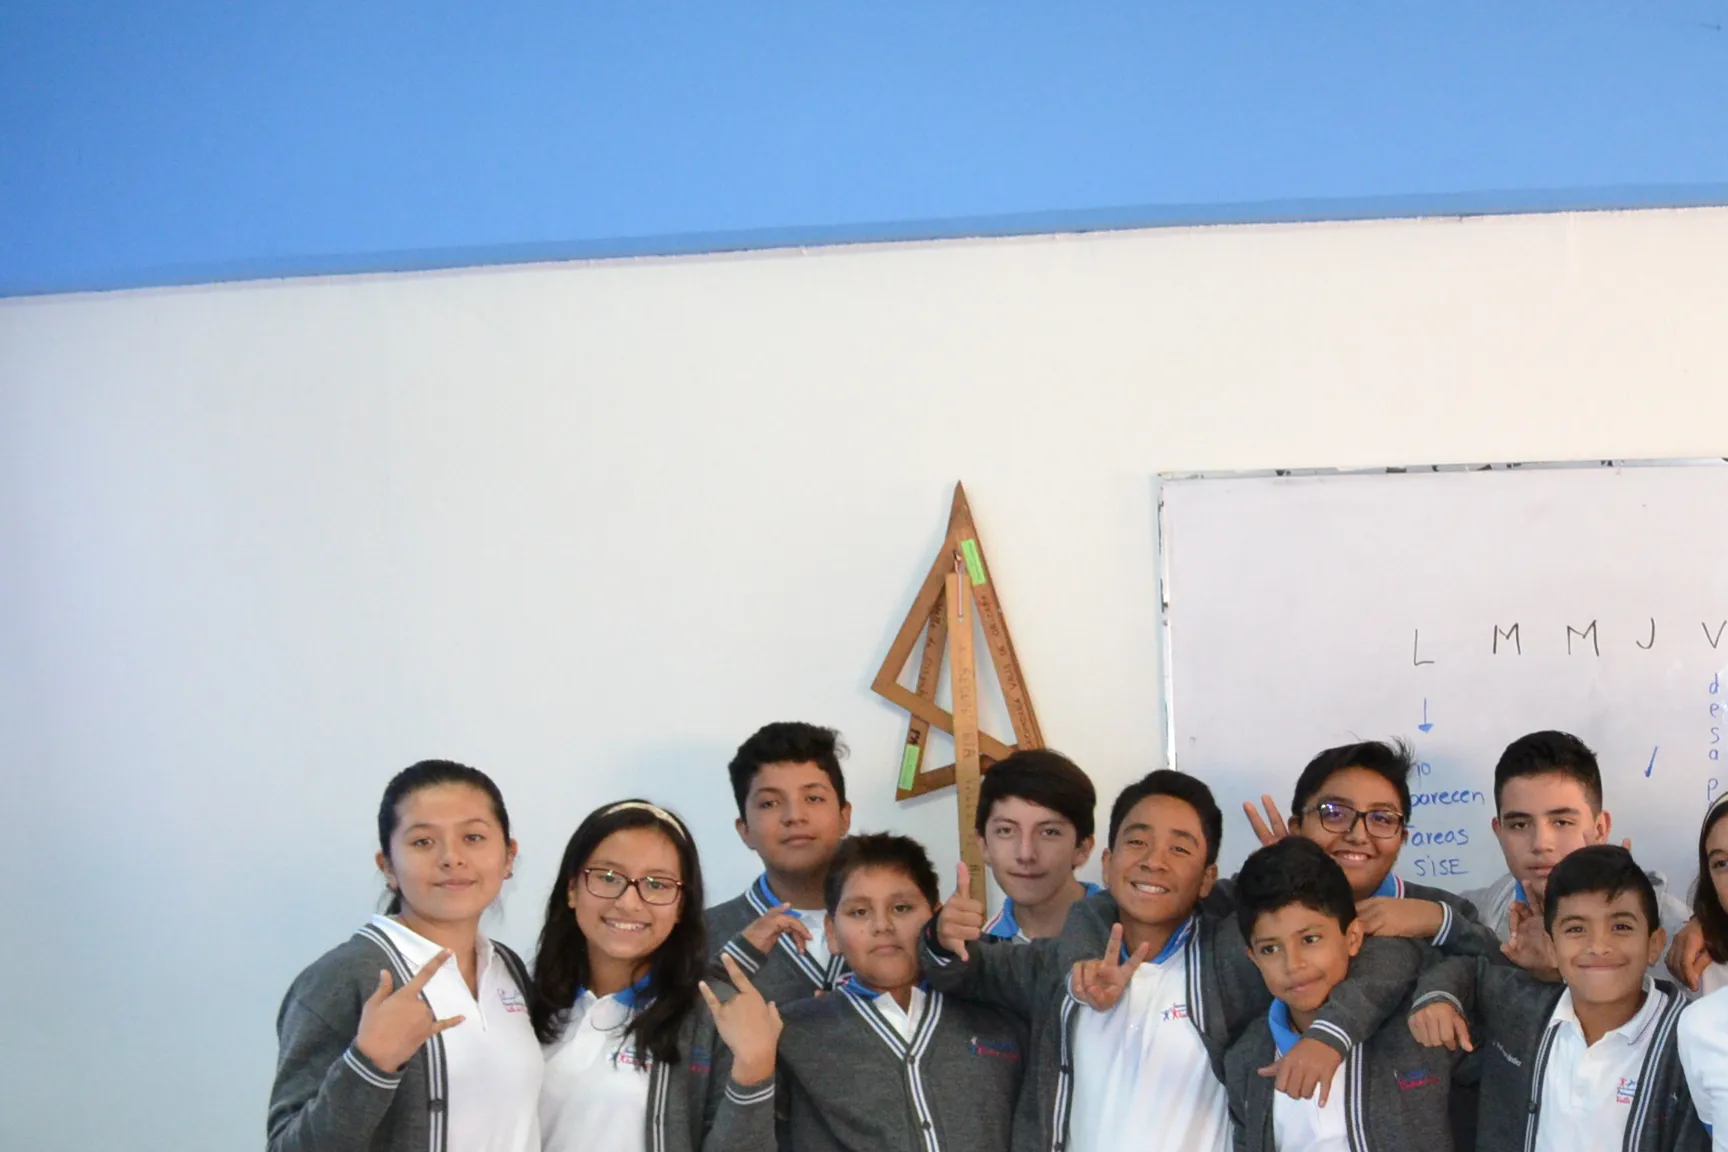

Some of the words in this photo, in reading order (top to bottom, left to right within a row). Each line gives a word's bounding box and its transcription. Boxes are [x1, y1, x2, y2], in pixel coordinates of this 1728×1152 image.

[1414, 629, 1435, 665] L
[1493, 622, 1521, 655] M
[1567, 621, 1600, 657] M
[1635, 618, 1656, 651] J
[1702, 620, 1727, 649] V
